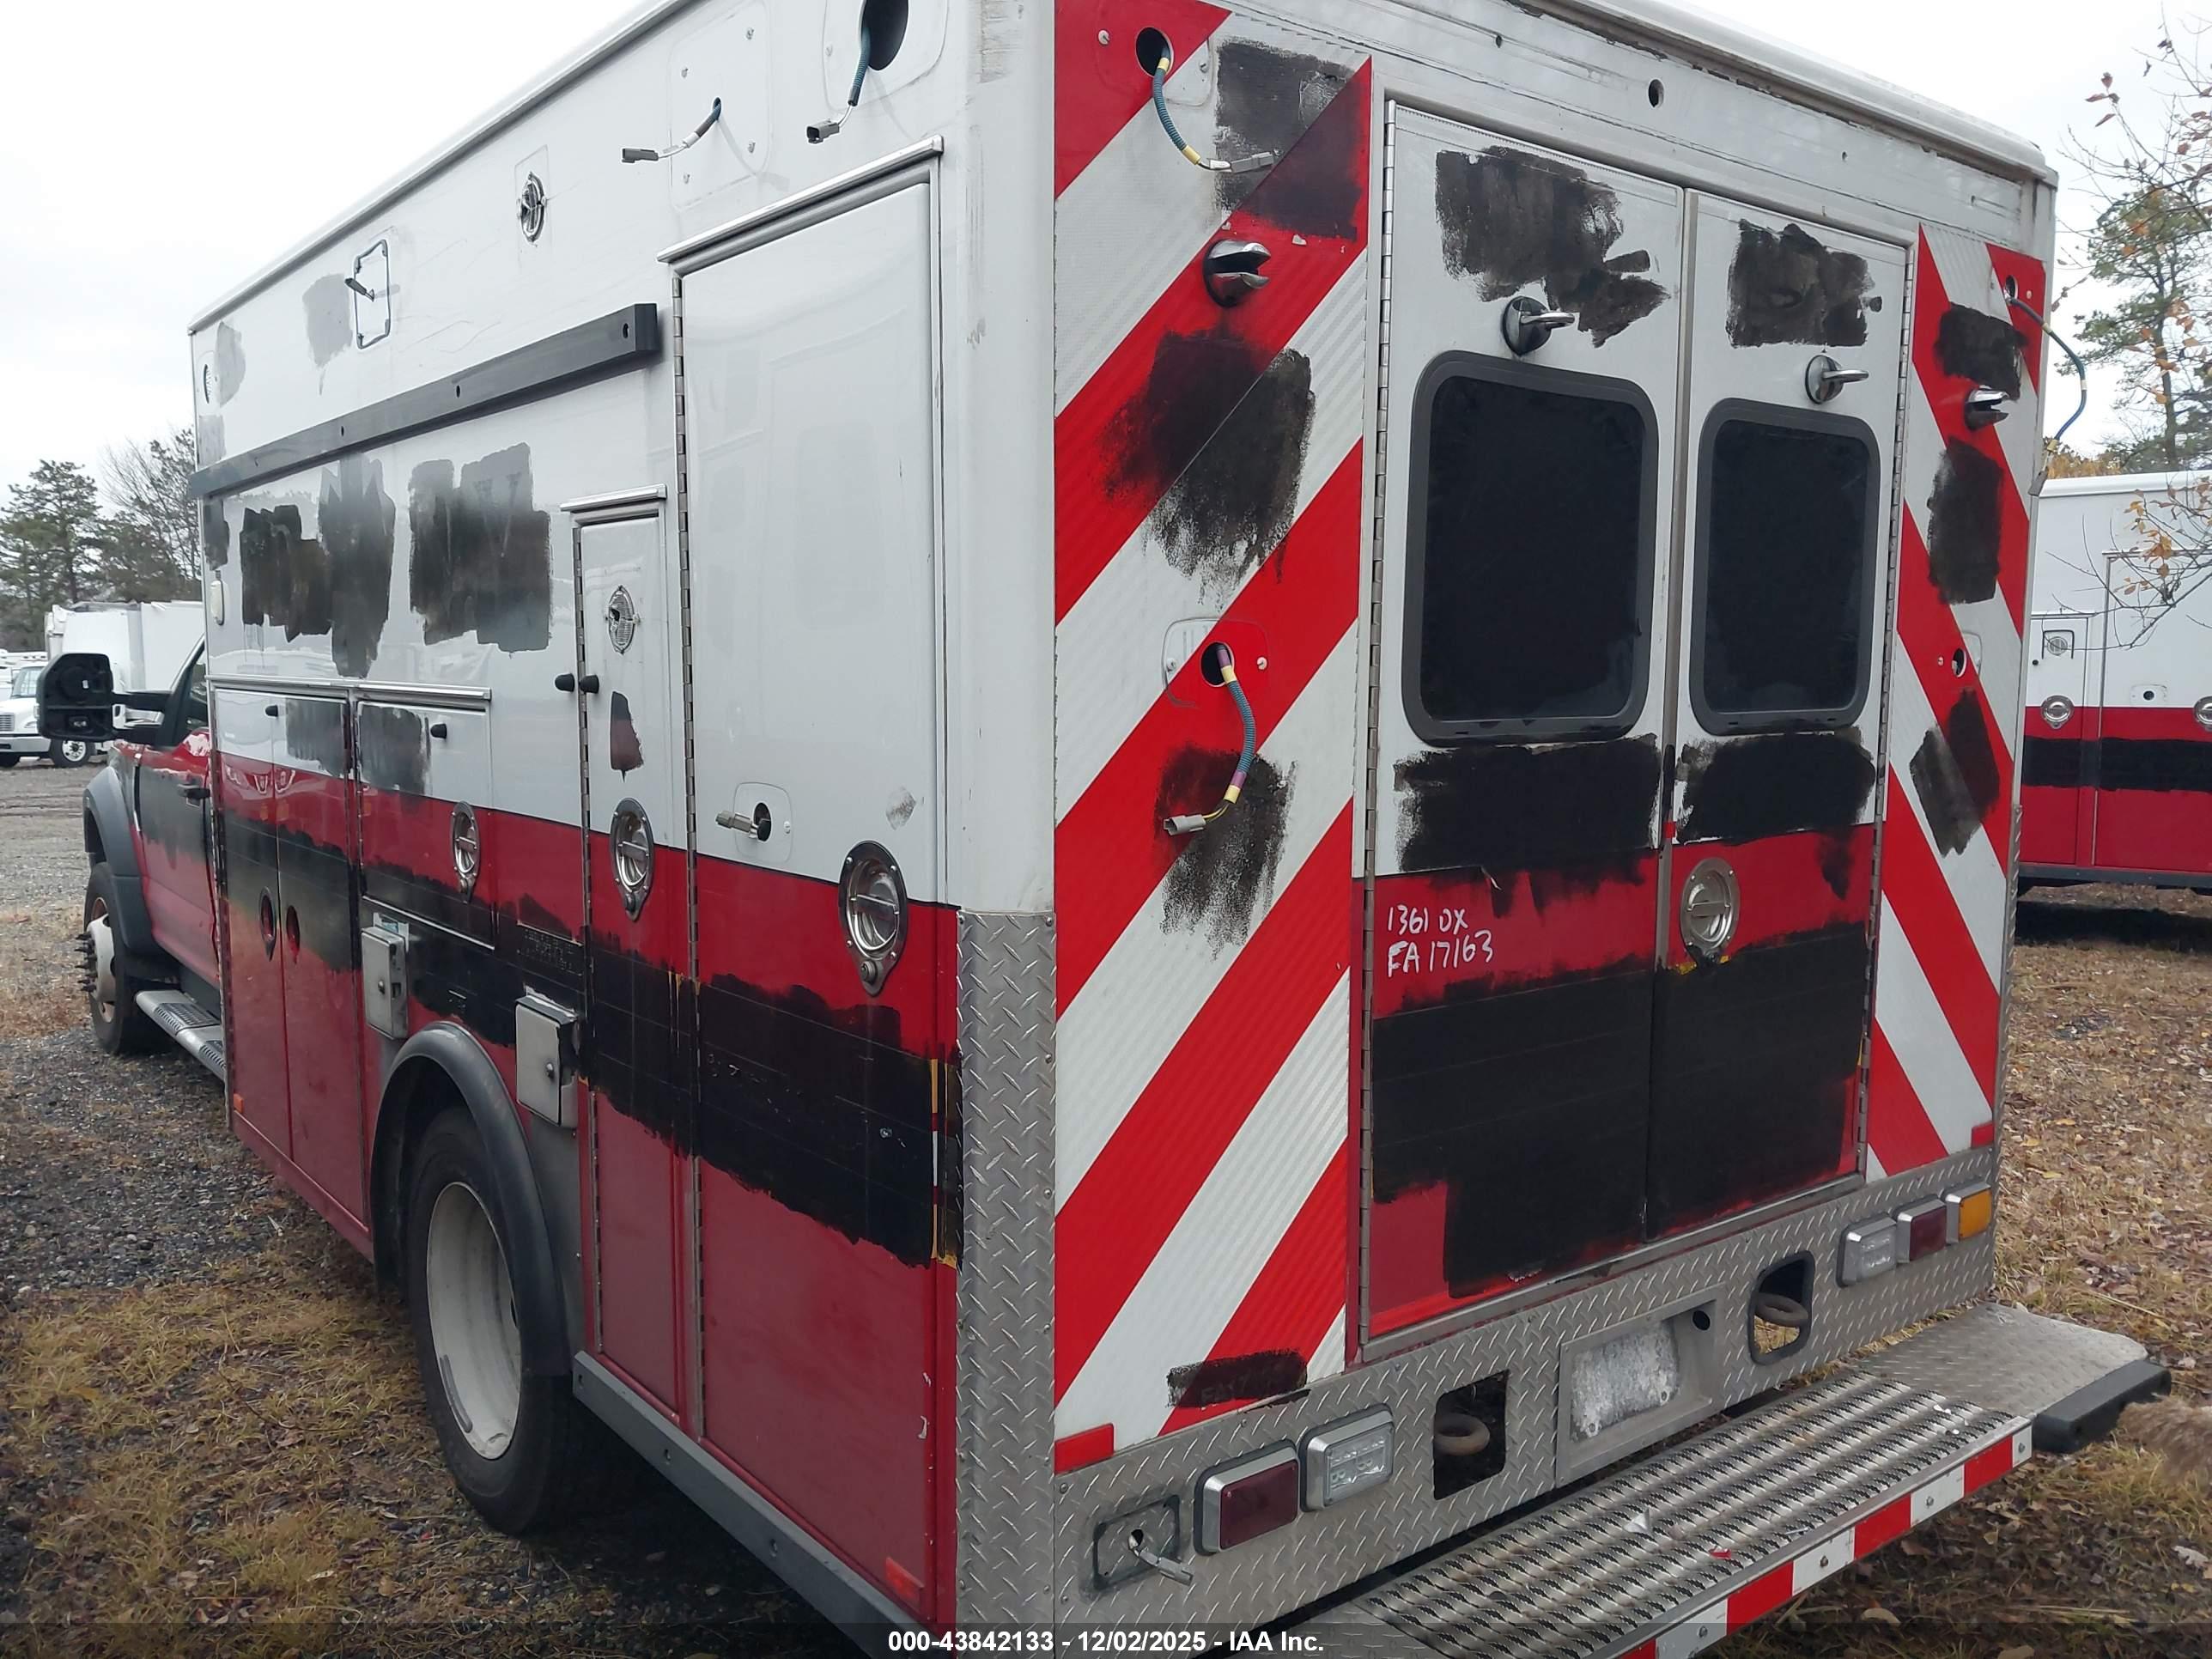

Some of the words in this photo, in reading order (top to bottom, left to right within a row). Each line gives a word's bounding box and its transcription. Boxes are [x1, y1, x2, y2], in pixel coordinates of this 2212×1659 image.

[1388, 904, 1429, 935] 1361
[1388, 940, 1420, 978] FA
[1429, 929, 1494, 972] 17163
